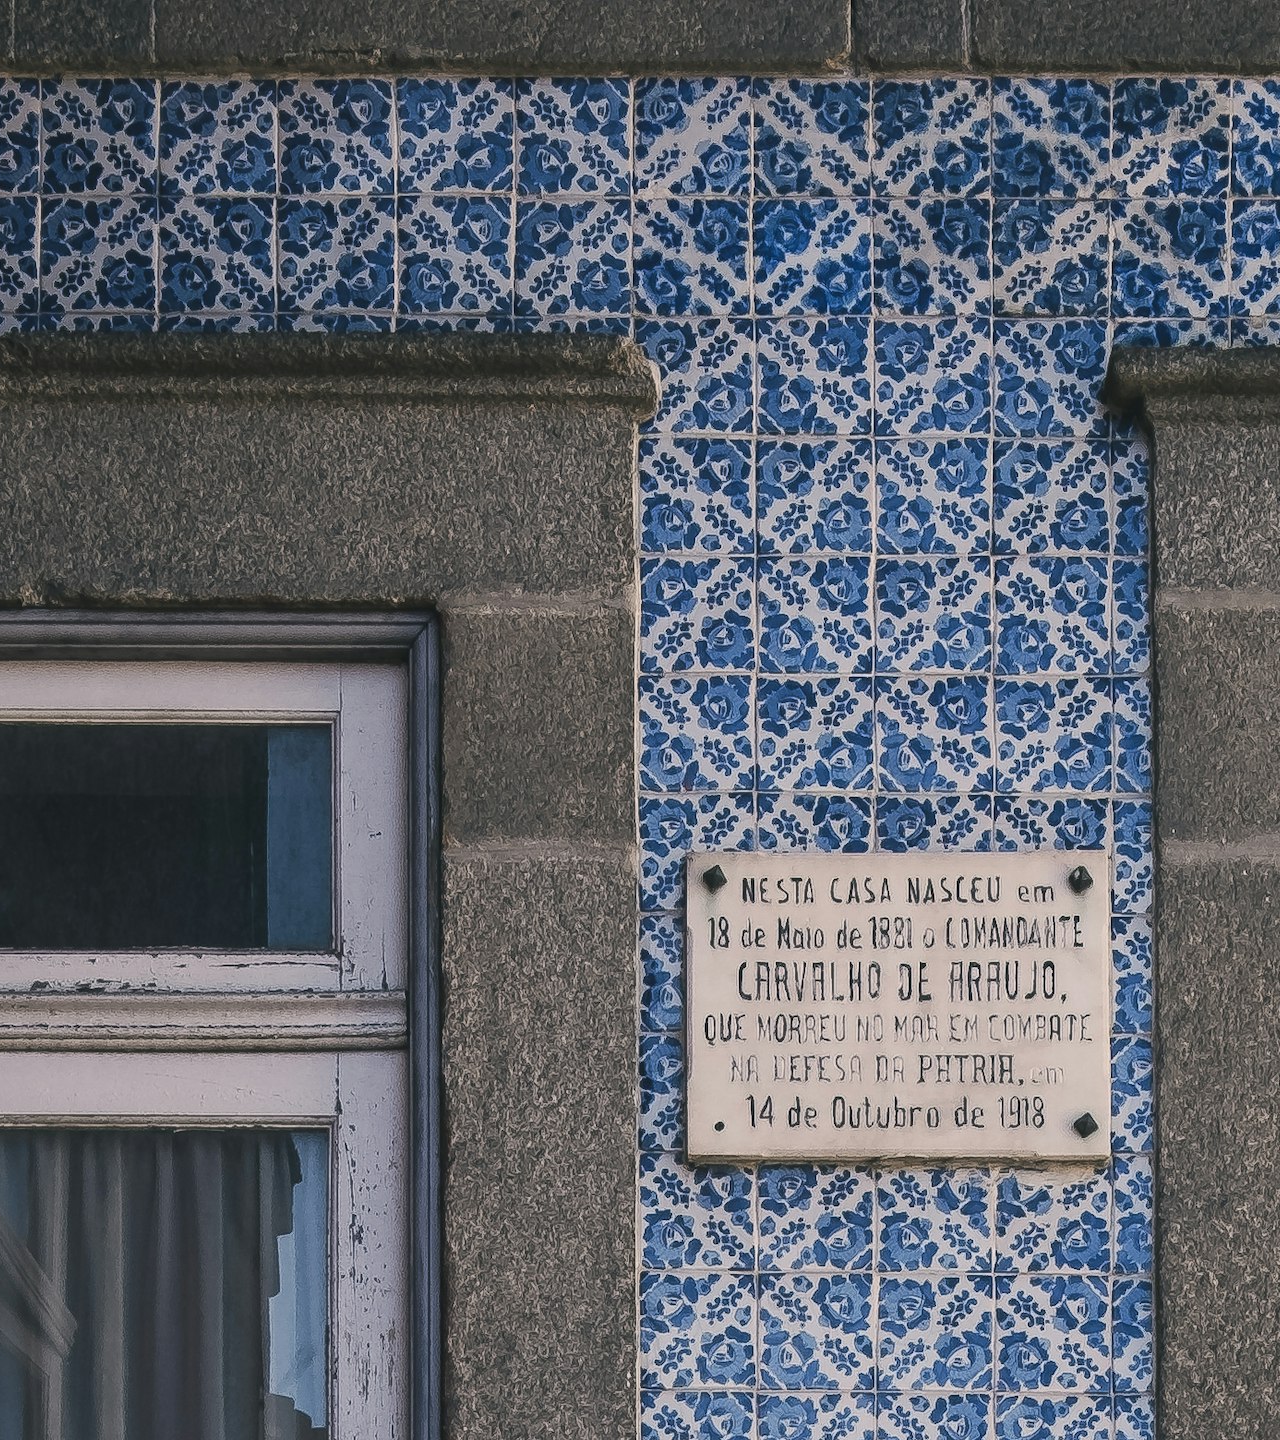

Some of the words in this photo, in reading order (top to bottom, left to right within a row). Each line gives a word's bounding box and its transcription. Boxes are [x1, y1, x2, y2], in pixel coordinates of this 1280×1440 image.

[742, 877, 815, 903] NESTA
[831, 877, 892, 903] CASA
[907, 877, 1001, 903] NASCEU
[1018, 882, 1055, 903] em
[708, 917, 730, 948] 18
[742, 920, 767, 948] de
[777, 917, 824, 949] Maio
[837, 920, 862, 949] de
[868, 917, 913, 949] 1881
[923, 927, 935, 948] o
[945, 916, 1084, 948] COMANDANTE
[738, 961, 881, 1001] CARVALHO
[898, 963, 931, 1000] DE
[949, 961, 1068, 1003] ARAUJO,
[704, 1014, 747, 1045] QUE
[757, 1014, 846, 1042] MORREU
[857, 1015, 883, 1042] NO
[894, 1015, 938, 1041] MAR
[949, 1015, 977, 1041] EM
[989, 1014, 1092, 1042] COMBATE
[731, 1056, 759, 1083] NA
[774, 1055, 861, 1083] DEFESA
[876, 1056, 904, 1083] DA
[746, 1096, 773, 1127] 14
[788, 1097, 817, 1127] de
[832, 1096, 939, 1128] Outubro
[954, 1097, 984, 1127] de
[997, 1096, 1045, 1127] 1918
